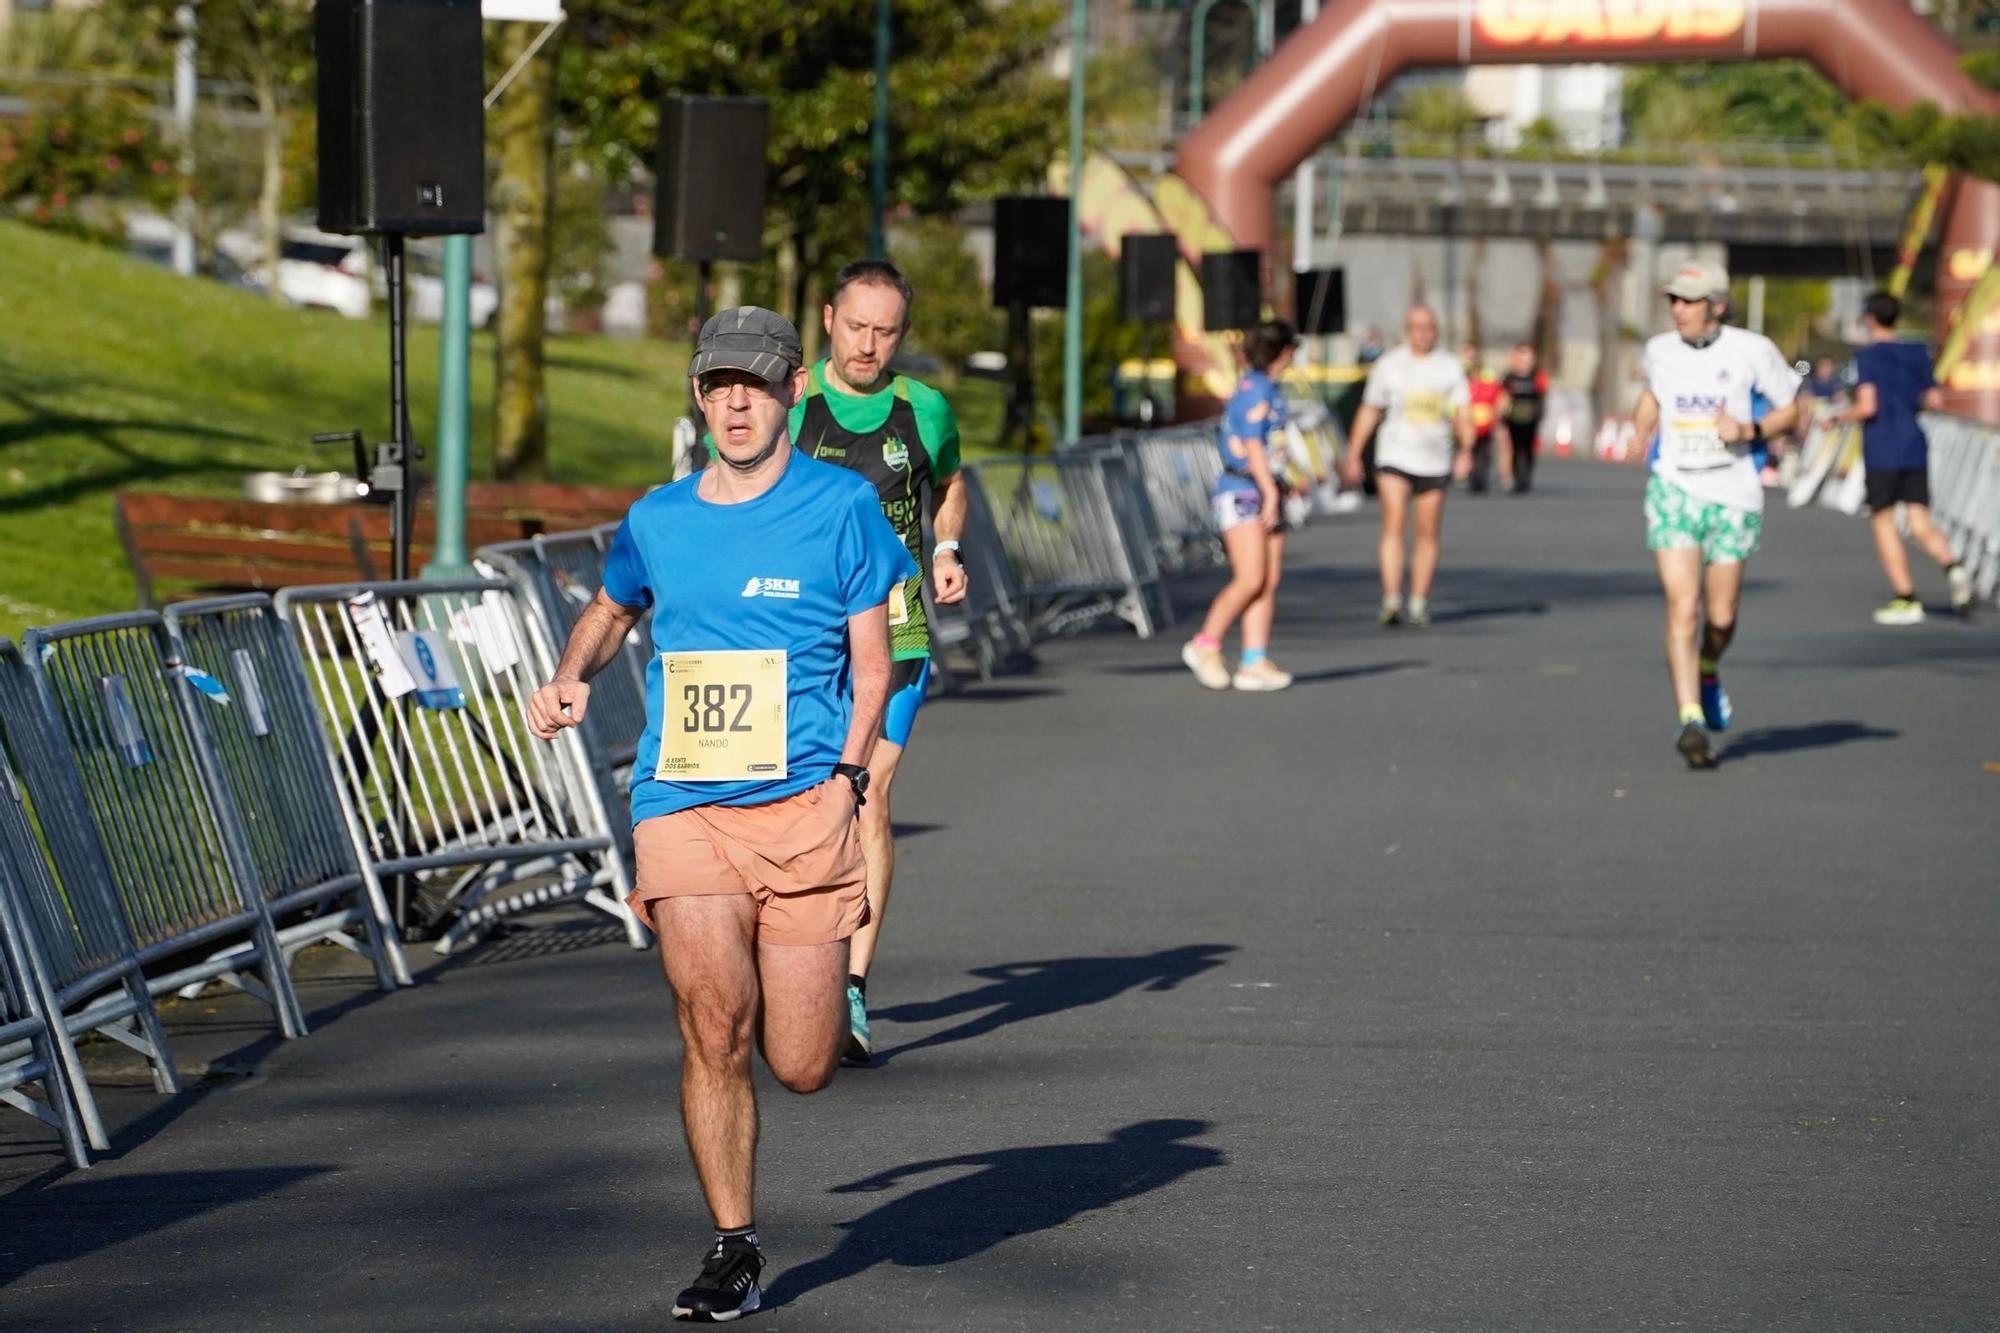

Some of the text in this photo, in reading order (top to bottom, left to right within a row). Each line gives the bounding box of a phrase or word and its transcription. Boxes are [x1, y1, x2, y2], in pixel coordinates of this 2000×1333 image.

[764, 578, 800, 591] 5KM
[684, 684, 752, 732] 382
[698, 739, 728, 748] NANDO
